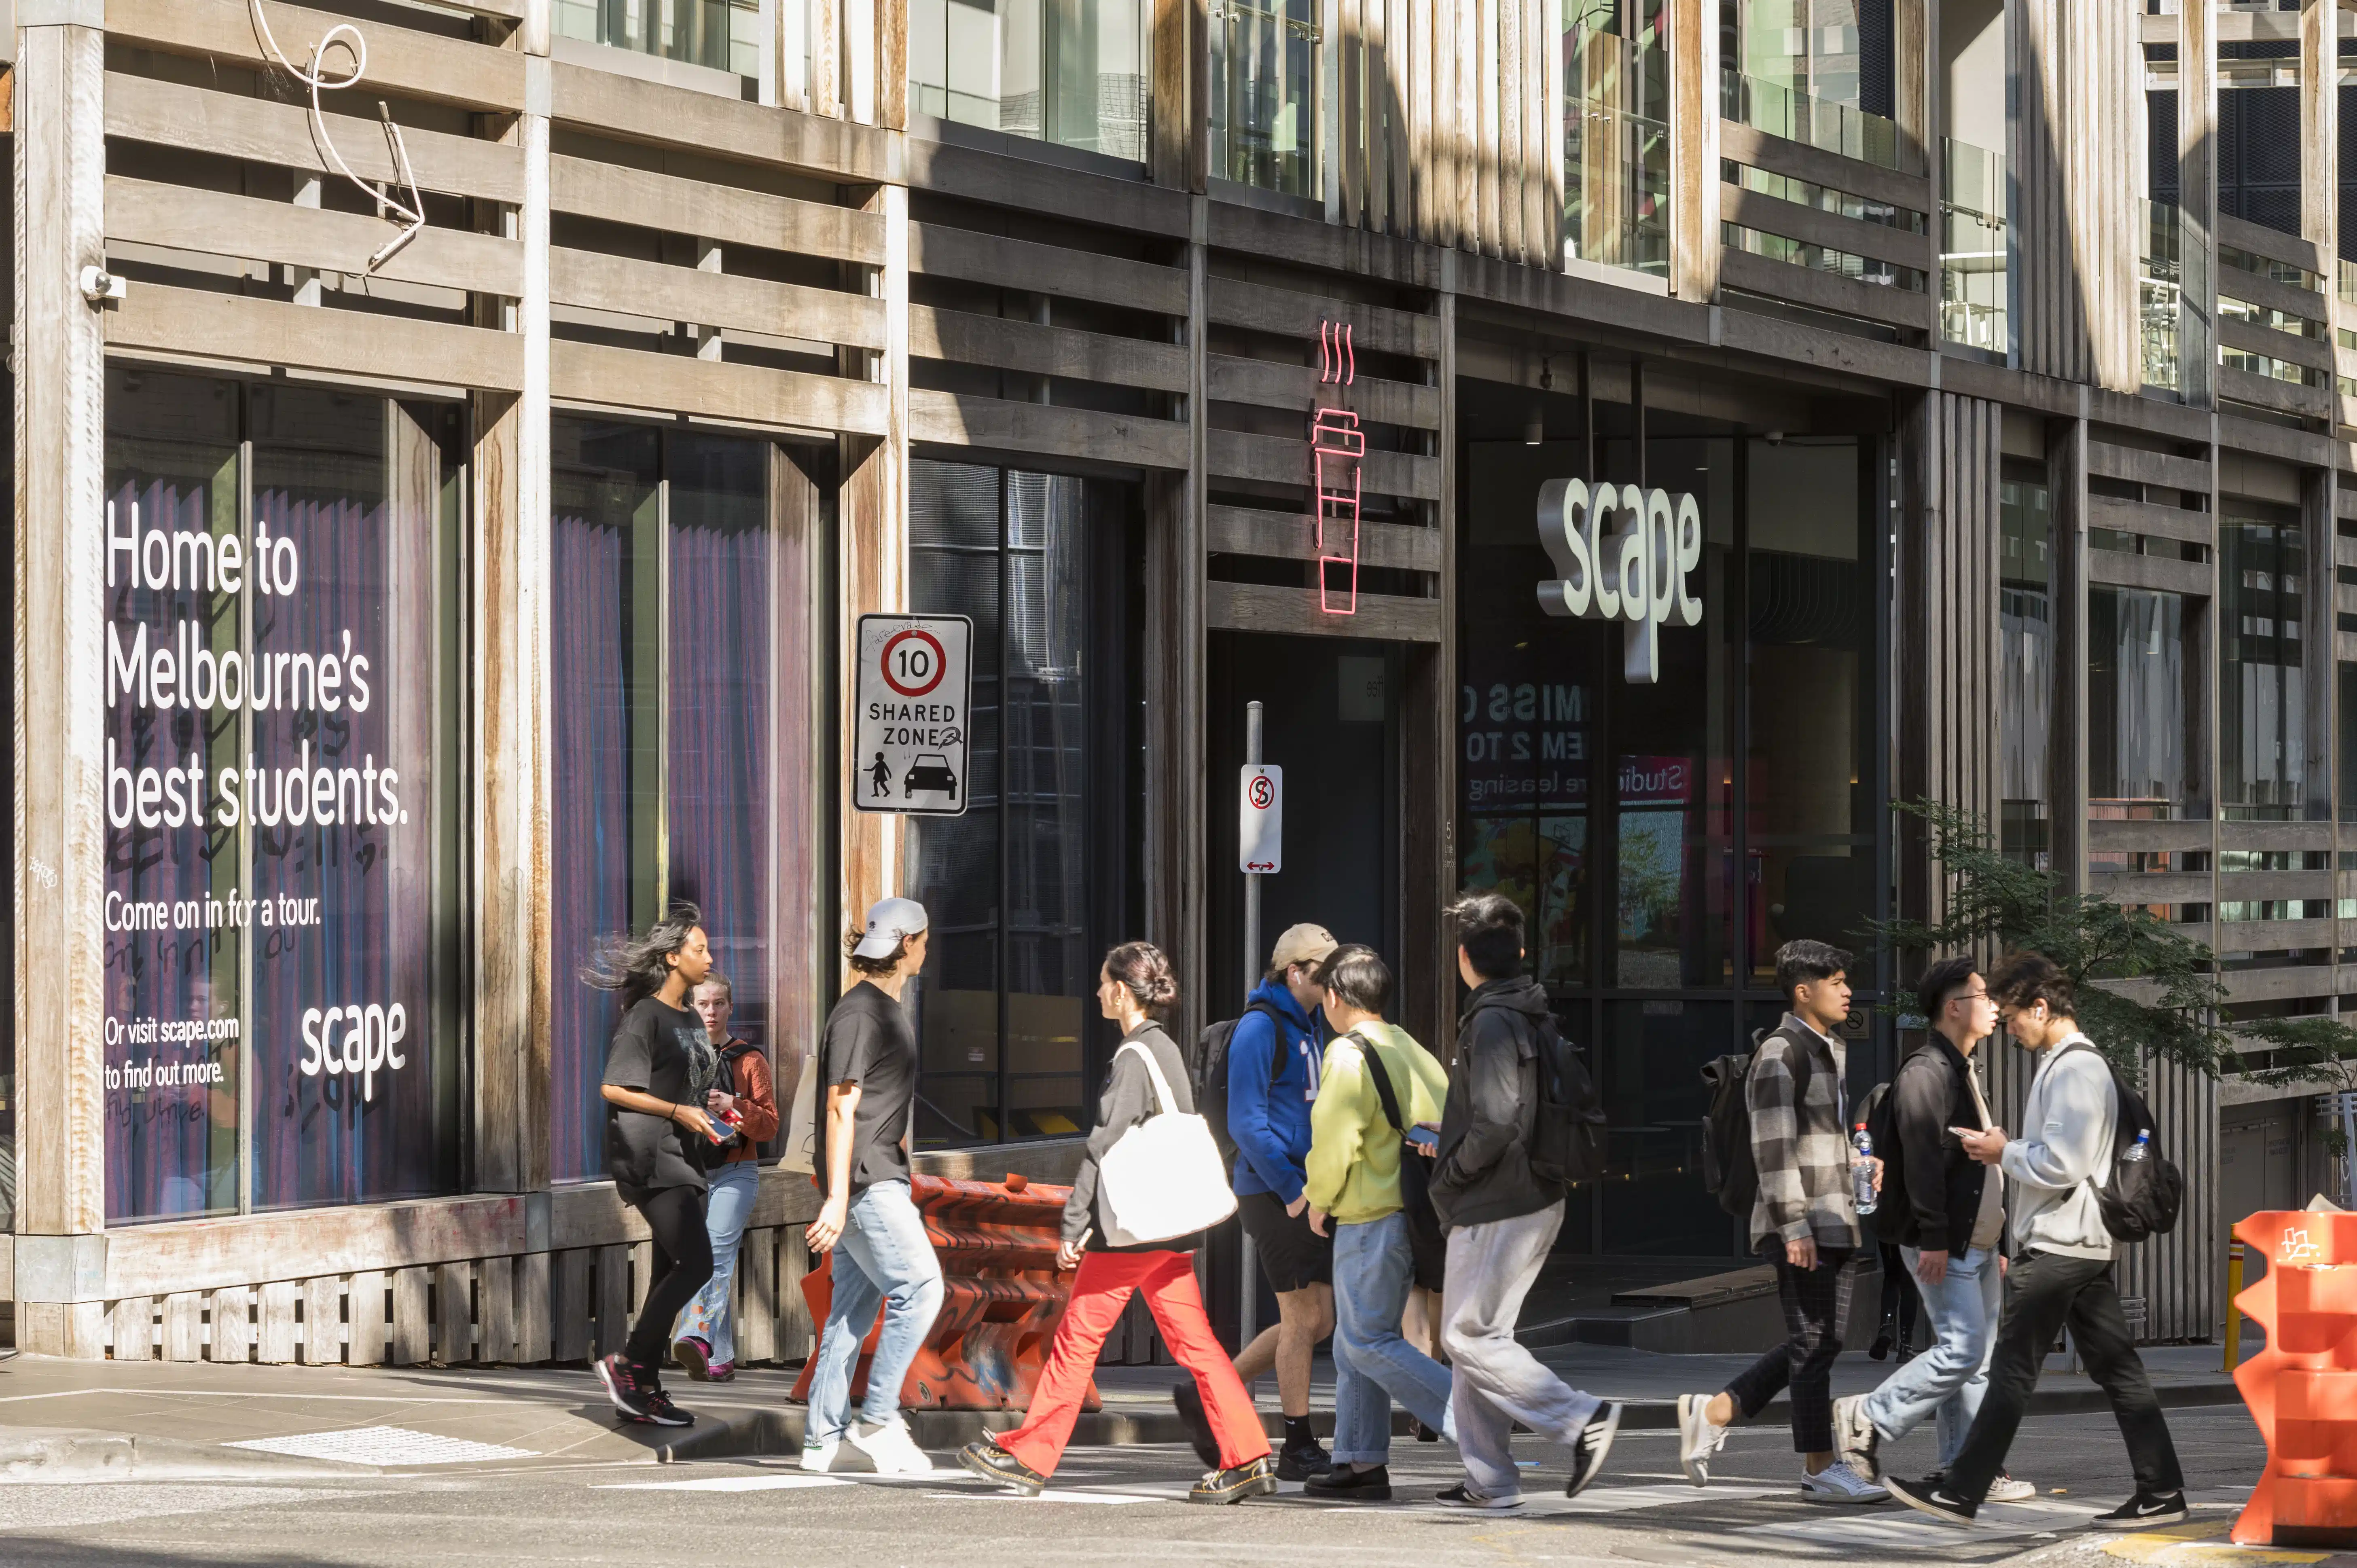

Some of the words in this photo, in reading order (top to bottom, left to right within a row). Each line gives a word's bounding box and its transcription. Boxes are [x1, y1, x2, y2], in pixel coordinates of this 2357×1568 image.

[108, 500, 242, 593] Home
[256, 521, 298, 596] to
[1562, 478, 1703, 683] scape
[108, 620, 370, 712] Melbourne's
[898, 650, 929, 677] 10
[869, 703, 955, 722] SHARED
[883, 728, 939, 746] ZONE
[108, 737, 203, 828] best
[218, 738, 408, 826] students.
[1446, 821, 1451, 840] 5
[1444, 843, 1453, 854] Little
[105, 891, 168, 931] Come
[174, 901, 199, 929] on
[205, 891, 223, 928] in
[229, 888, 256, 927] for
[261, 899, 273, 927] a
[278, 892, 320, 926] tour.
[105, 1016, 125, 1045] Or
[127, 1017, 157, 1044] visit
[161, 1018, 239, 1048] scape.com
[301, 1003, 407, 1102] scape
[105, 1065, 120, 1089] to
[124, 1058, 152, 1088] find
[155, 1060, 180, 1086] out
[183, 1062, 224, 1084] more.
